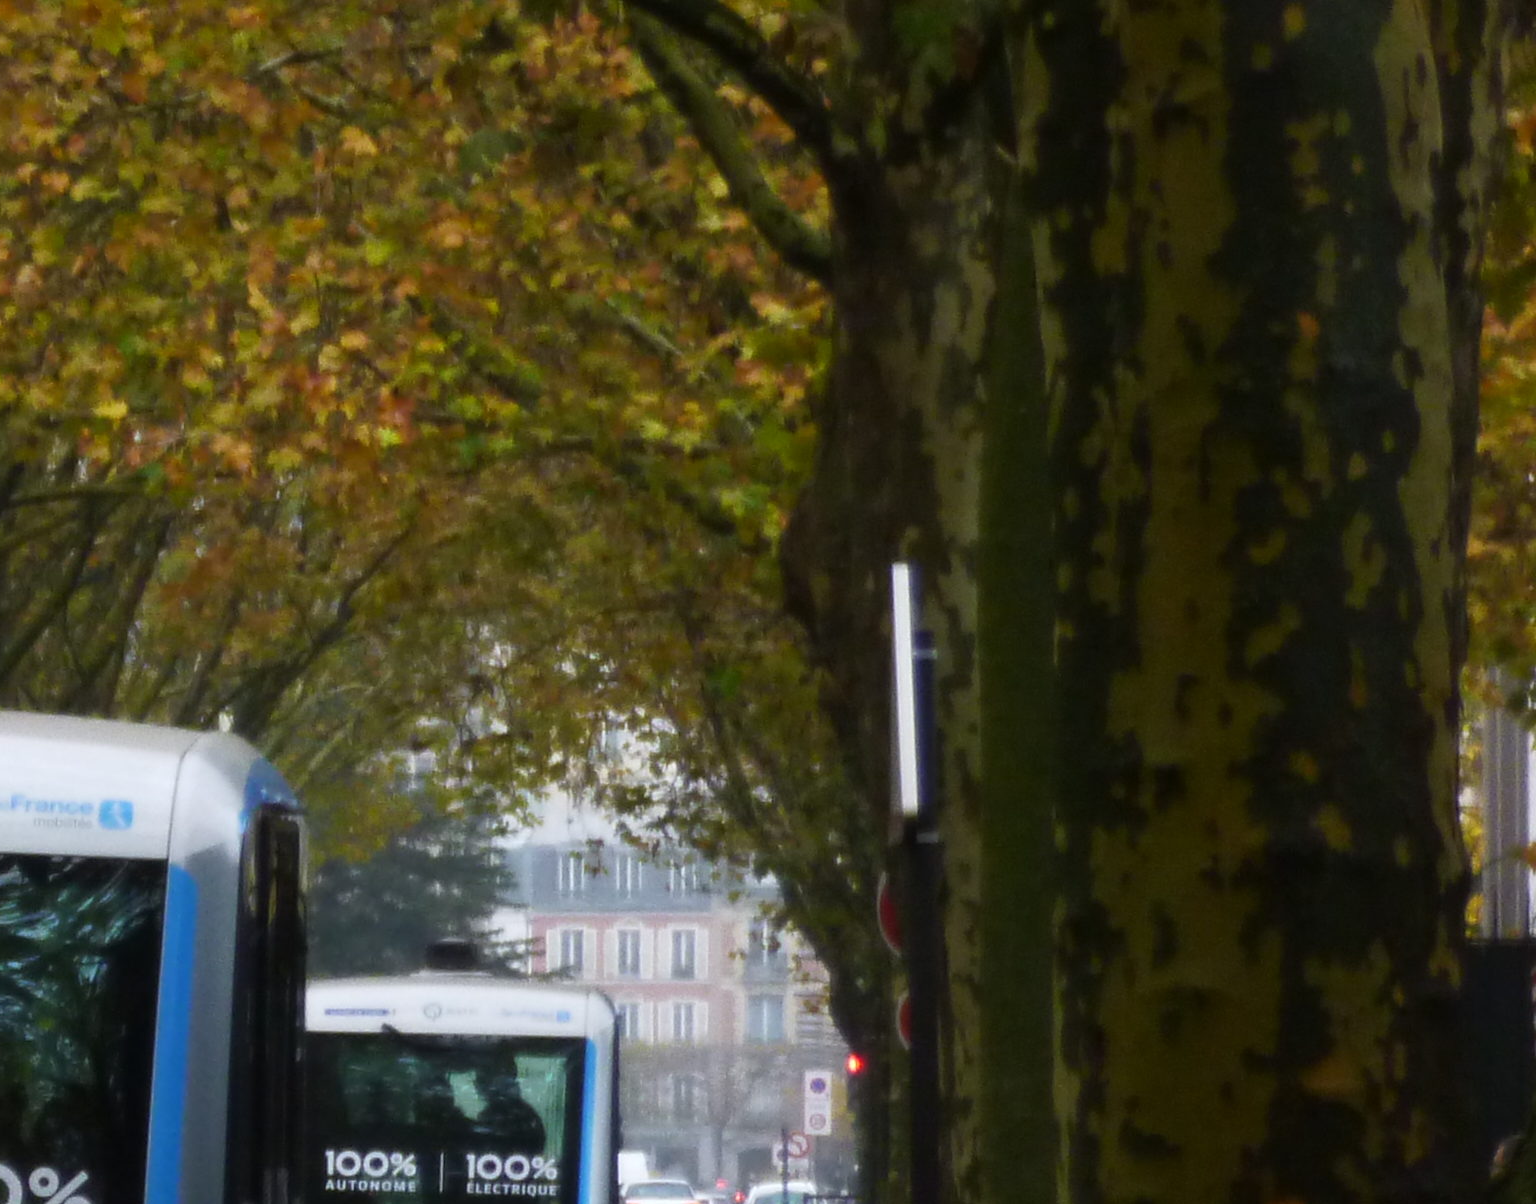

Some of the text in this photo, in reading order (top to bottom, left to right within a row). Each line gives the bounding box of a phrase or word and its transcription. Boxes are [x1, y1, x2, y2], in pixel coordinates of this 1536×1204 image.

[325, 1149, 417, 1178] 100%
[466, 1153, 558, 1181] 100%
[325, 1179, 417, 1193] AUTONOME
[466, 1181, 558, 1198] ÉLECTRIQUE
